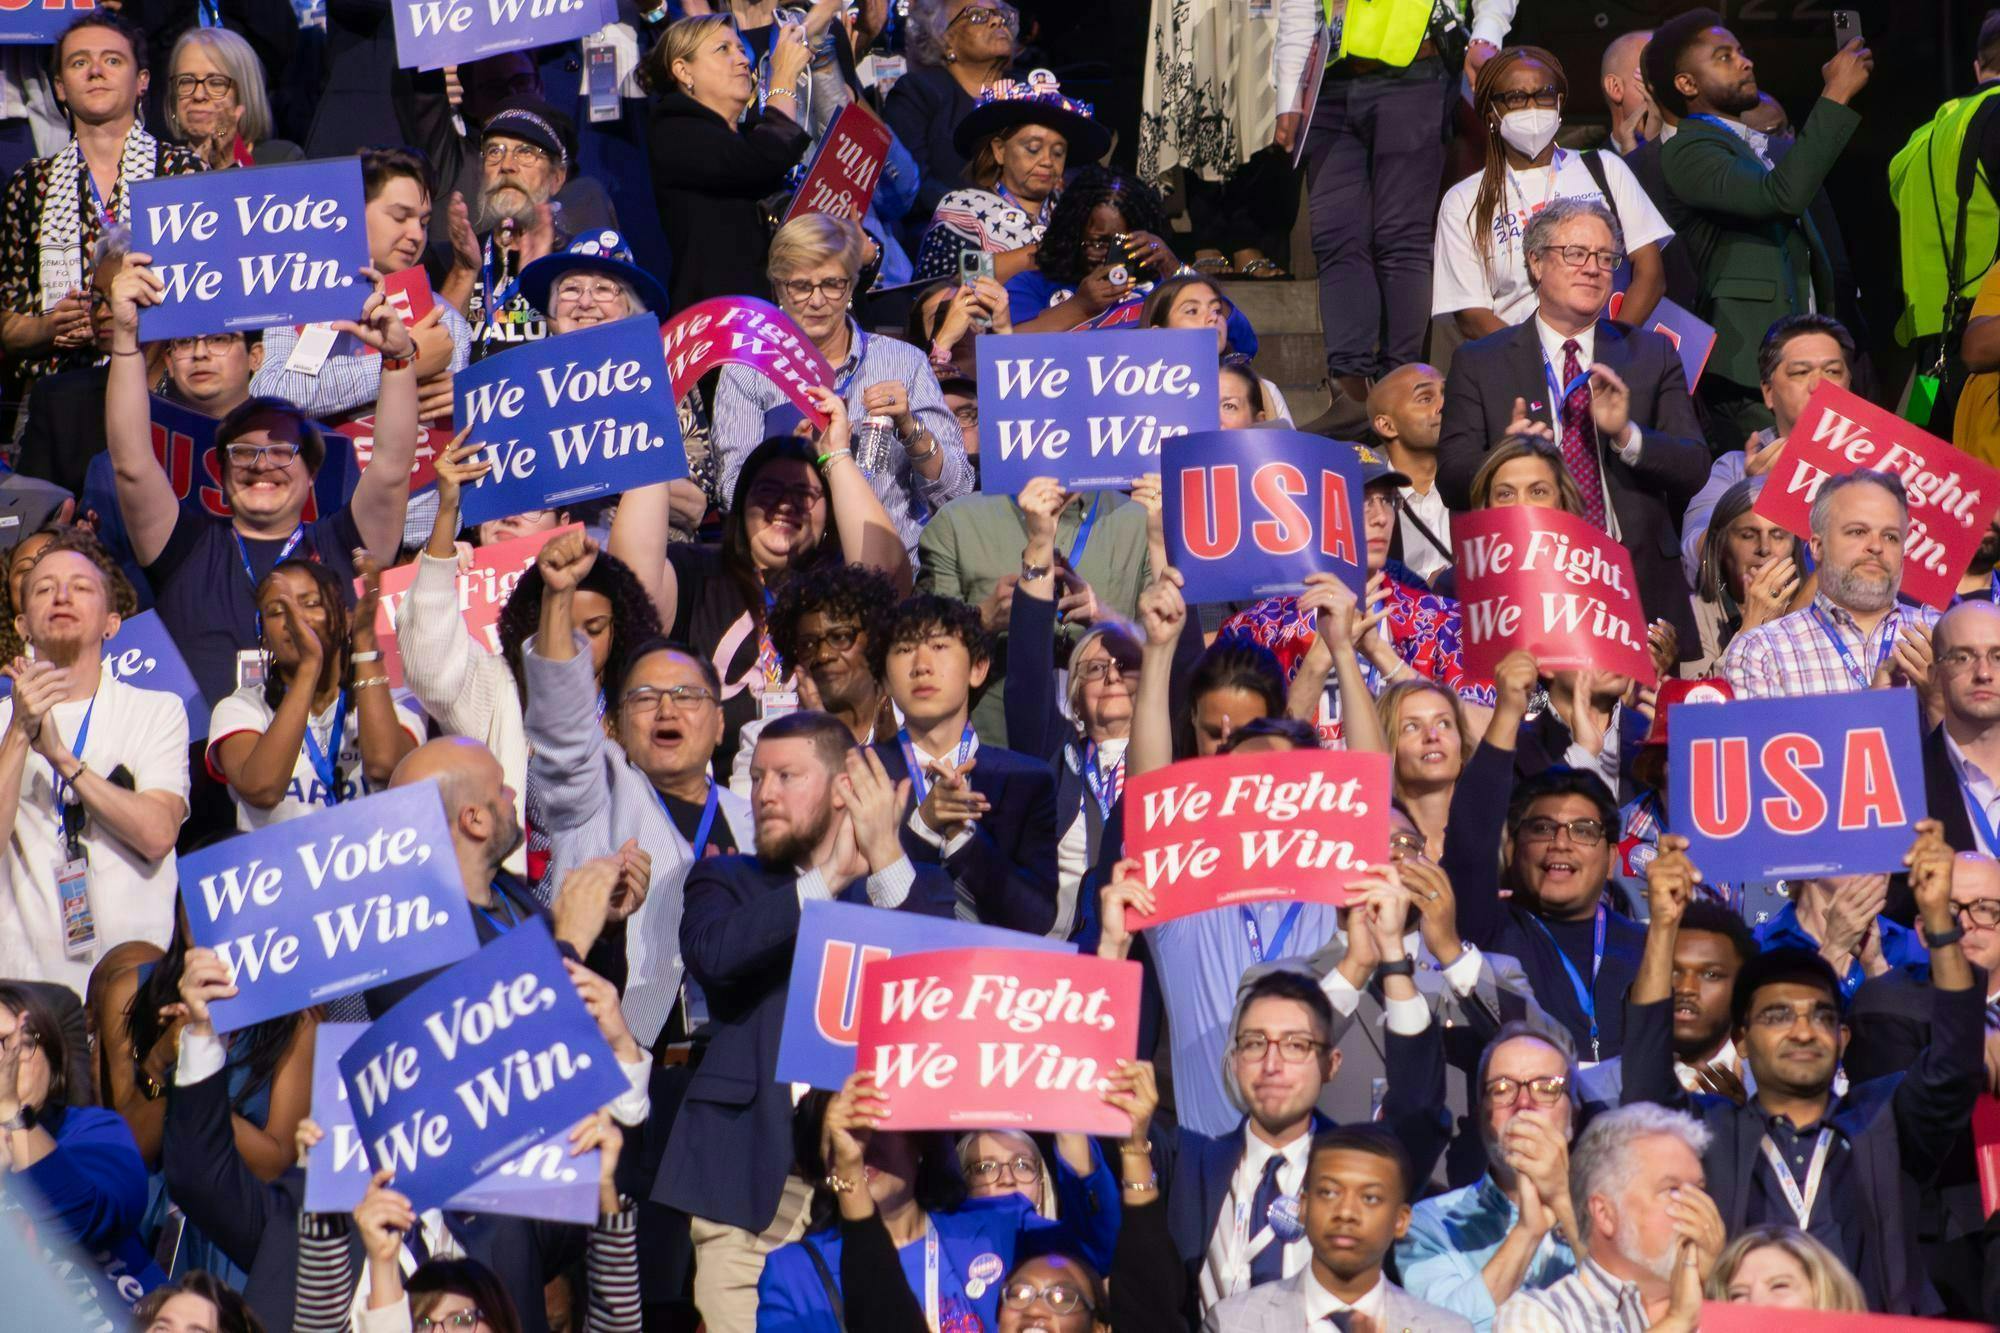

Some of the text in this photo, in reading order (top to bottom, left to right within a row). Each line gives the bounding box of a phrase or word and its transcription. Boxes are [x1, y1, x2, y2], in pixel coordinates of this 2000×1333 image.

[408, 3, 474, 38] We
[147, 194, 348, 246] We Vote,
[151, 252, 353, 304] We Win.
[471, 320, 554, 342] VALU
[664, 306, 823, 383] We Fight,
[464, 358, 653, 425] We Vote,
[667, 340, 715, 385] We
[995, 355, 1201, 400] We Vote,
[467, 439, 537, 488] We
[548, 418, 665, 470] Win.
[997, 418, 1071, 462] We
[1811, 407, 1981, 528] We Fight,
[1181, 461, 1359, 567] USA
[1462, 530, 1632, 600] We Fight,
[1468, 592, 1642, 651] We Win.
[101, 649, 157, 682] te,
[1143, 771, 1369, 833] We Fight,
[1691, 727, 1908, 840] USA
[199, 827, 432, 923] We Vote,
[1143, 829, 1370, 891] We Win.
[213, 927, 300, 988] We
[312, 894, 450, 960] Win.
[881, 976, 955, 1026] We
[956, 974, 1116, 1033] Fight,
[355, 973, 557, 1118] We Vote,
[874, 1042, 1115, 1092] We Win.
[374, 1109, 453, 1186] We
[455, 1042, 592, 1131] Win.
